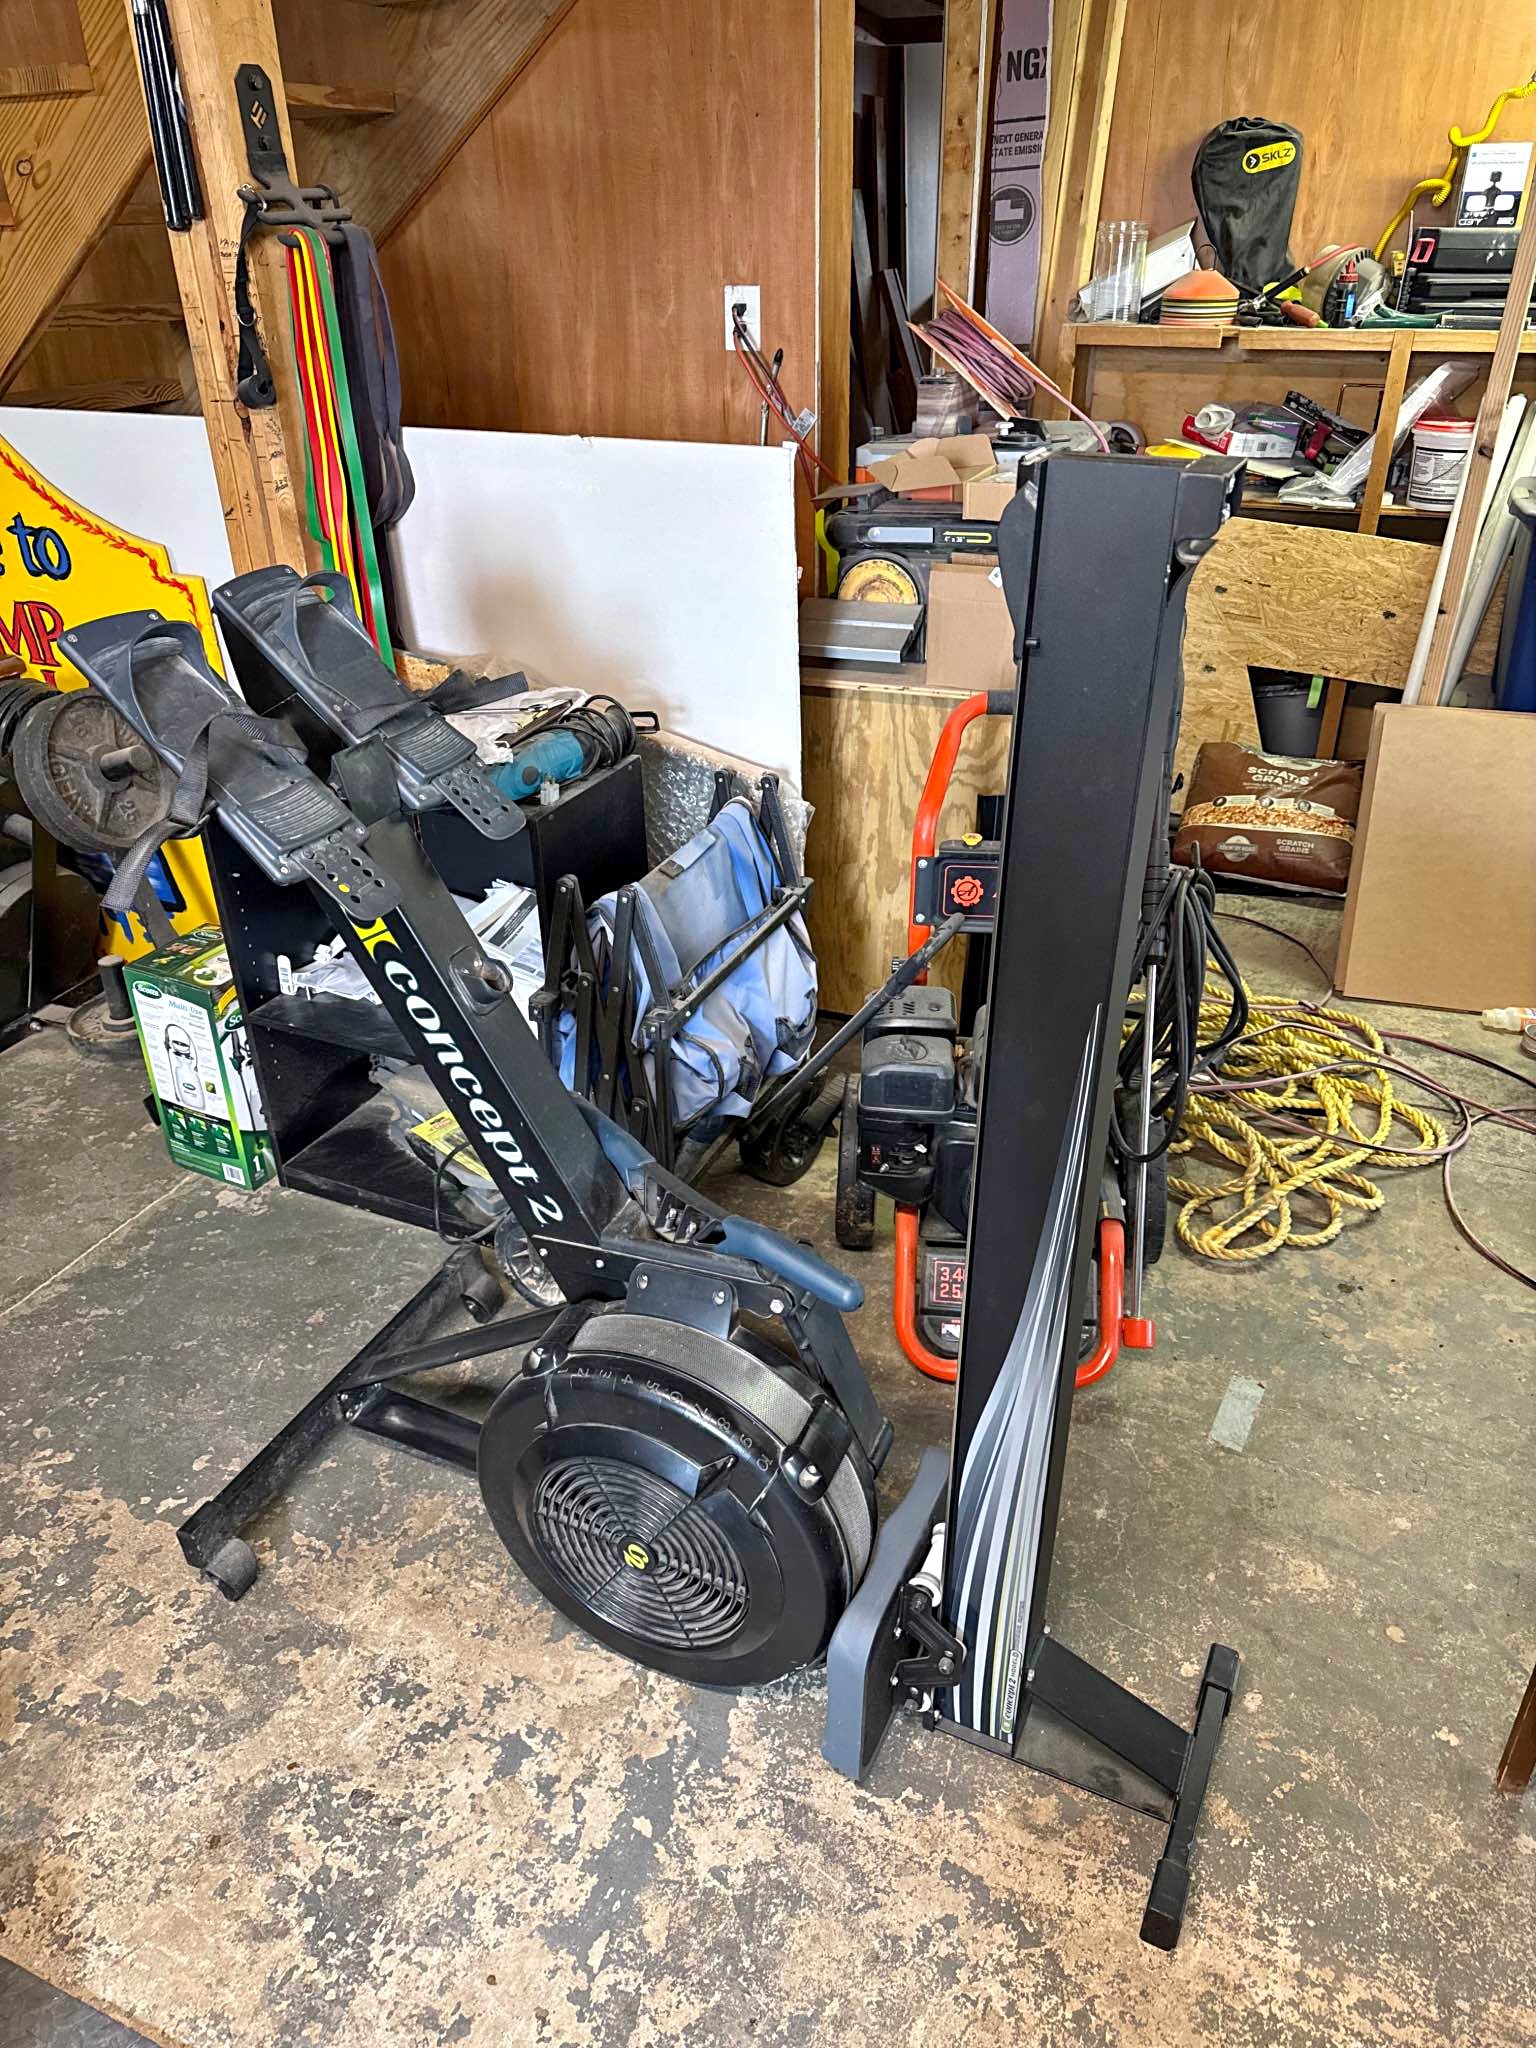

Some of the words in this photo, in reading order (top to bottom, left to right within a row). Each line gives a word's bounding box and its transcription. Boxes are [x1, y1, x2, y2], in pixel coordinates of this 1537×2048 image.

[991, 145, 1012, 158] TATE
[1262, 147, 1291, 163] SKLZ
[6, 512, 72, 581] to
[1276, 838, 1315, 849] SCRATCH
[1278, 845, 1310, 854] GRAINS
[137, 983, 159, 997] Scotts
[252, 1155, 261, 1172] 1
[527, 1193, 564, 1226] 2
